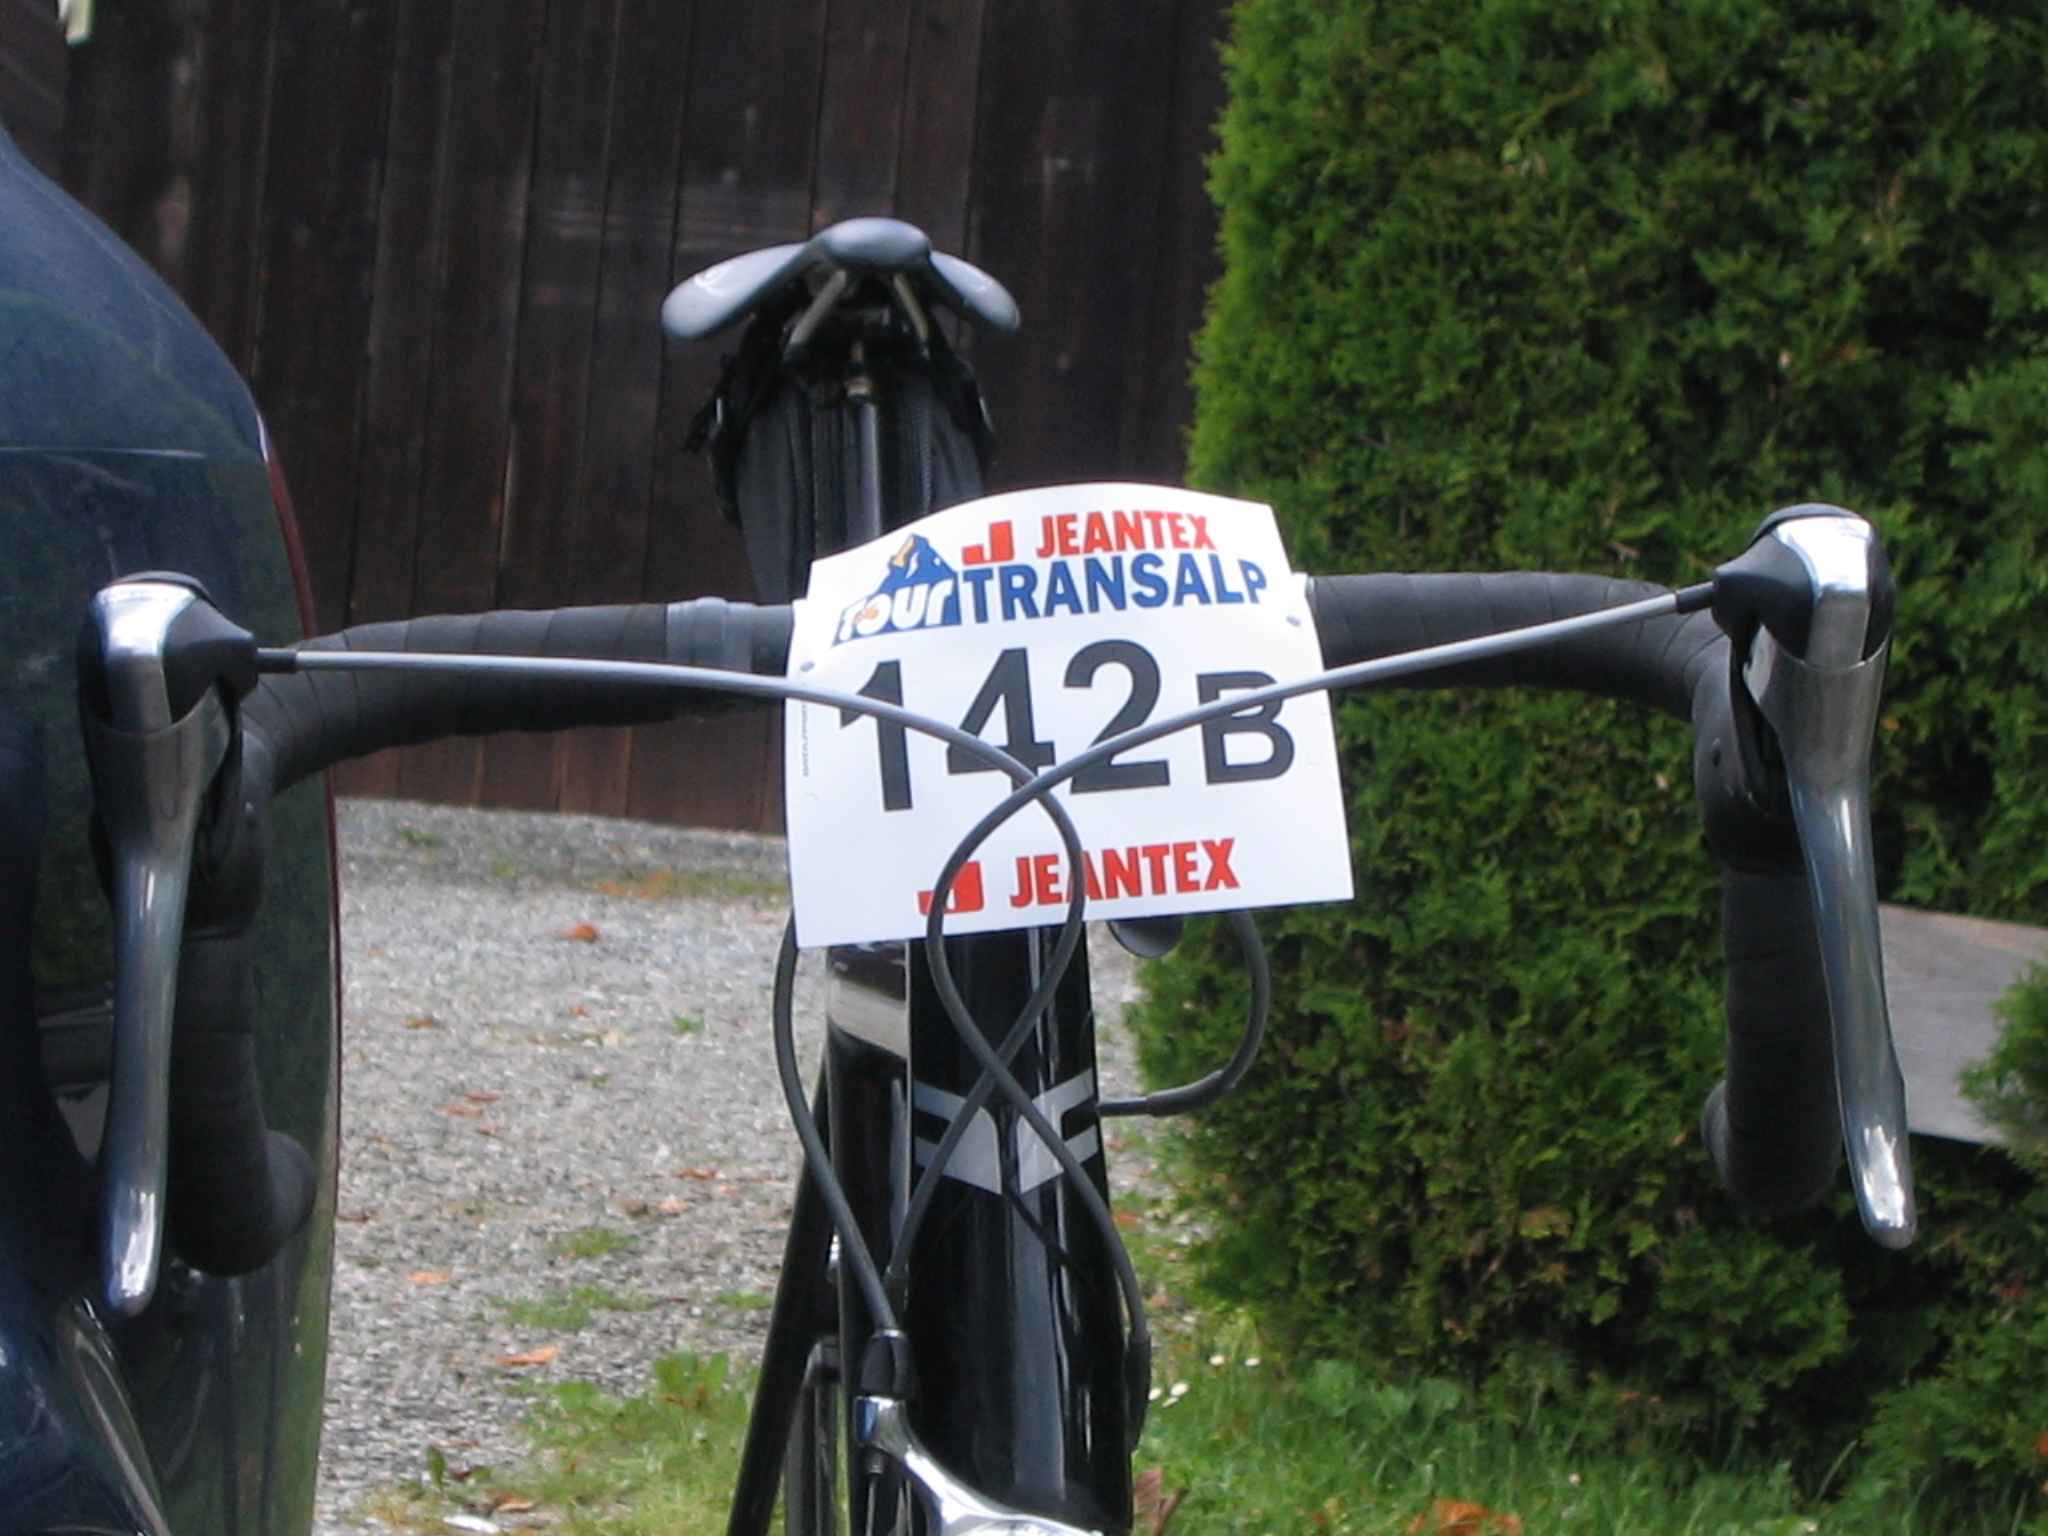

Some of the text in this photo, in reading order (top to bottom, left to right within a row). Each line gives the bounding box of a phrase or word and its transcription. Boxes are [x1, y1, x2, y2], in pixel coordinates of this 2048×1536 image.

[1035, 509, 1218, 558] JEANTEX
[961, 552, 1268, 624] TRANSALP
[1009, 838, 1240, 908] JEANTEX
